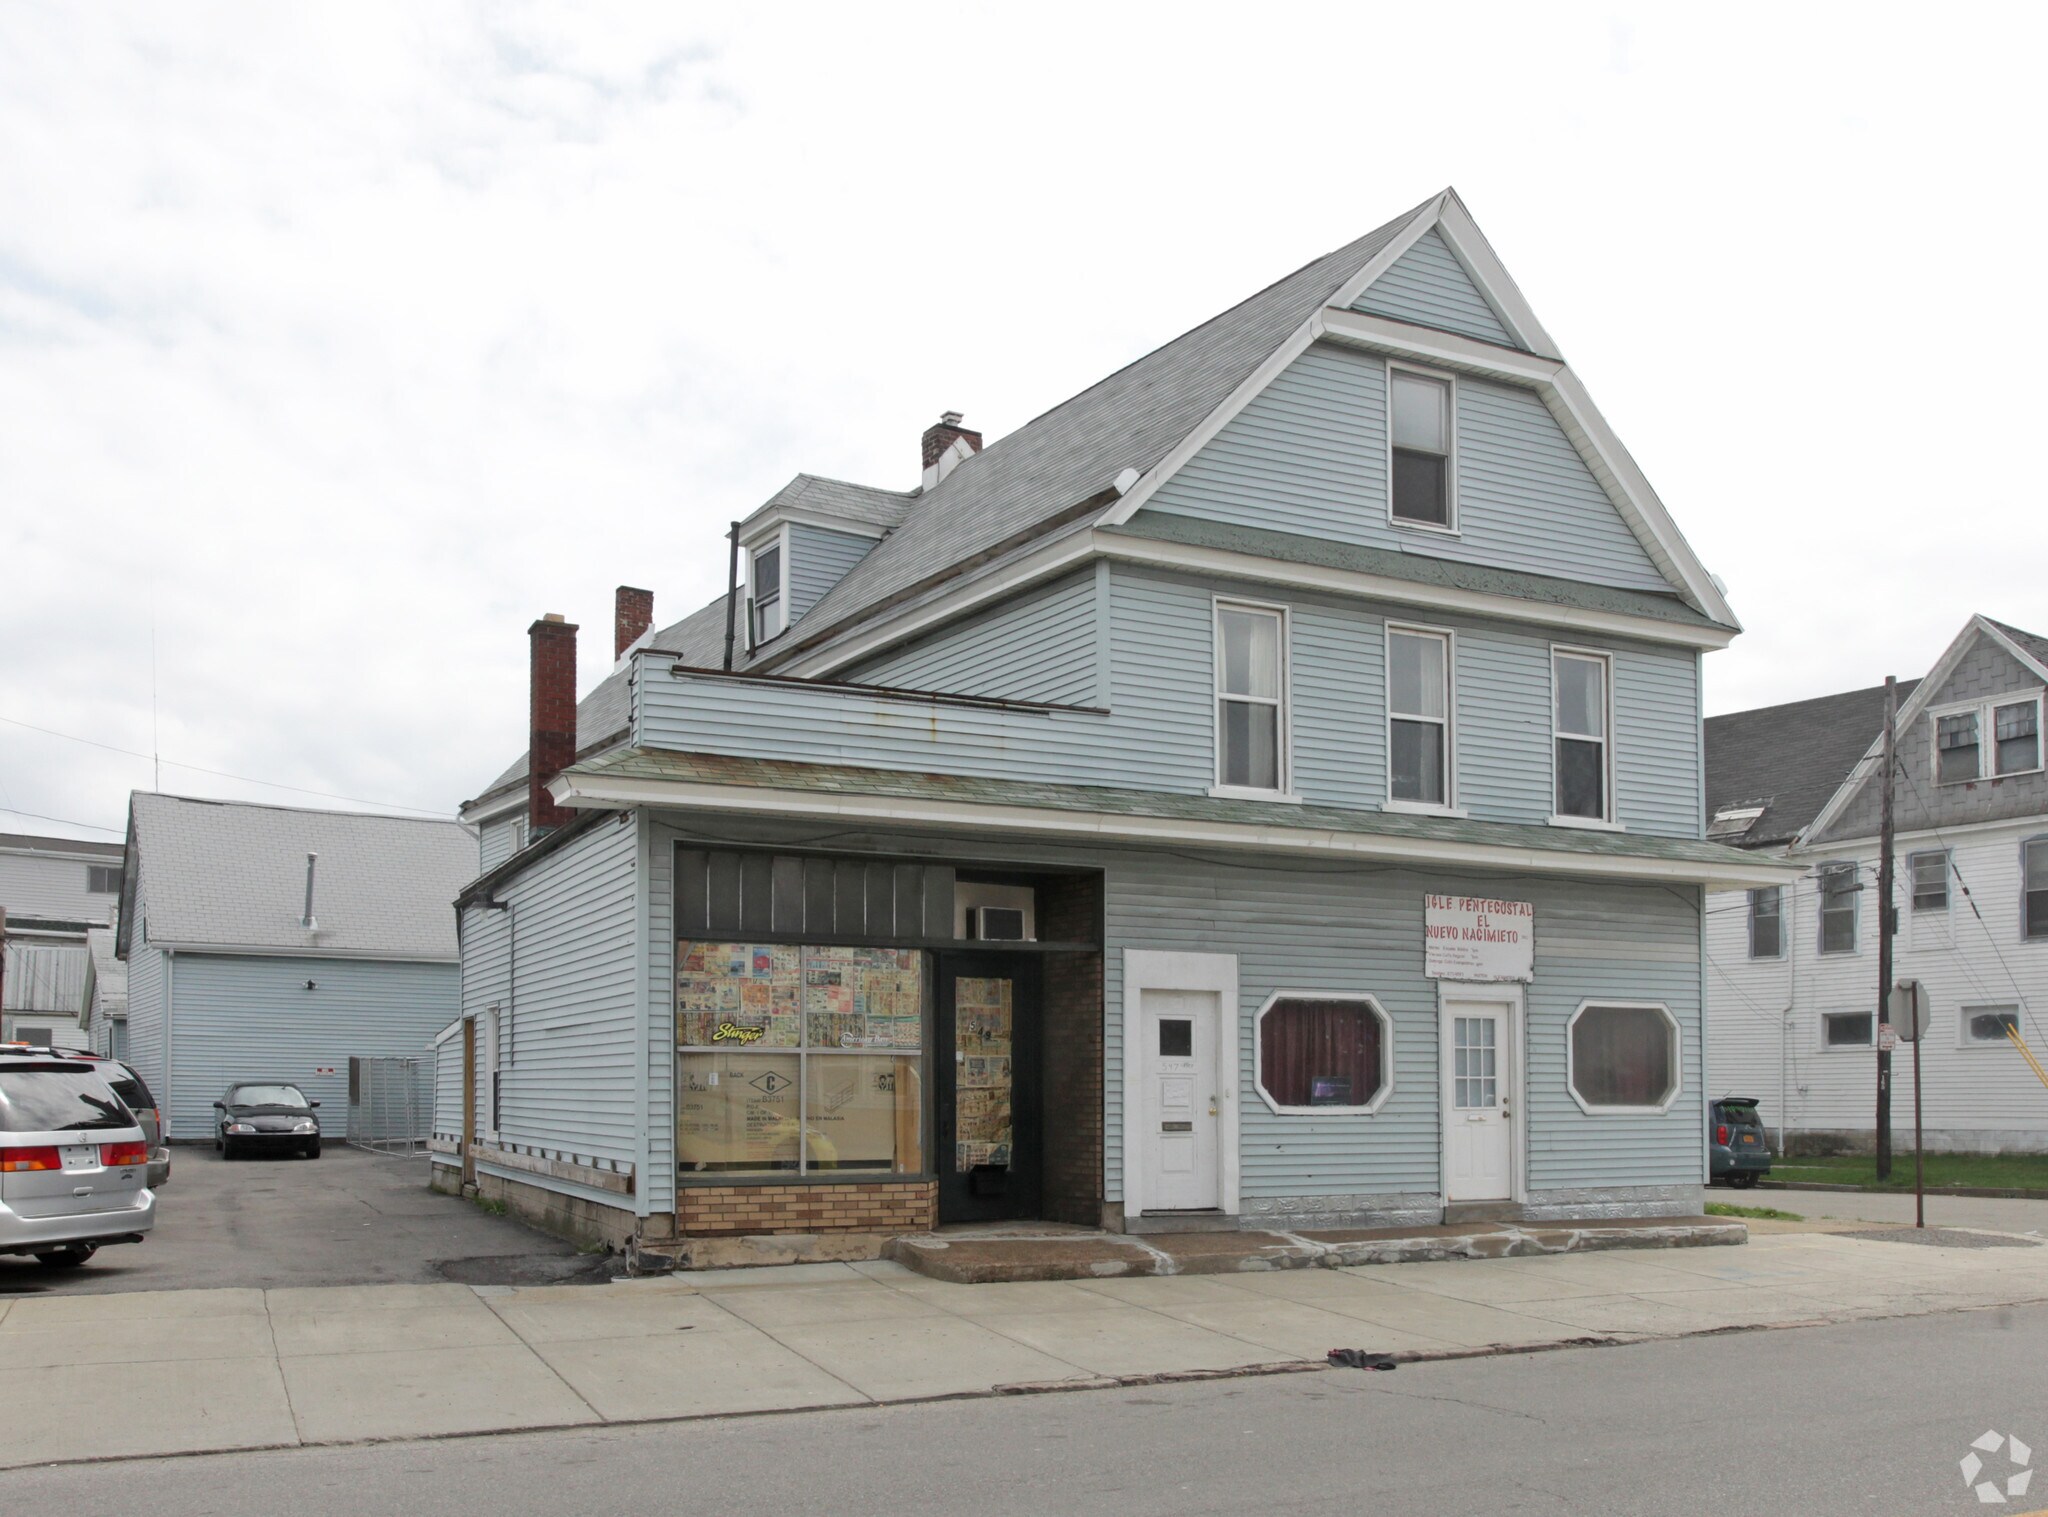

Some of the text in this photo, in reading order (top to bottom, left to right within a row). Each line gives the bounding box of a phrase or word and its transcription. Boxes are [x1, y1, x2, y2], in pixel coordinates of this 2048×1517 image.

[1459, 898, 1532, 916] PENTECOSTAL
[1477, 914, 1490, 928] EL
[1426, 924, 1458, 940] NUEVO
[1462, 927, 1518, 944] NACIMIETO
[712, 1022, 764, 1046] Stinger
[766, 1075, 776, 1091] C
[762, 1095, 784, 1104] B3751
